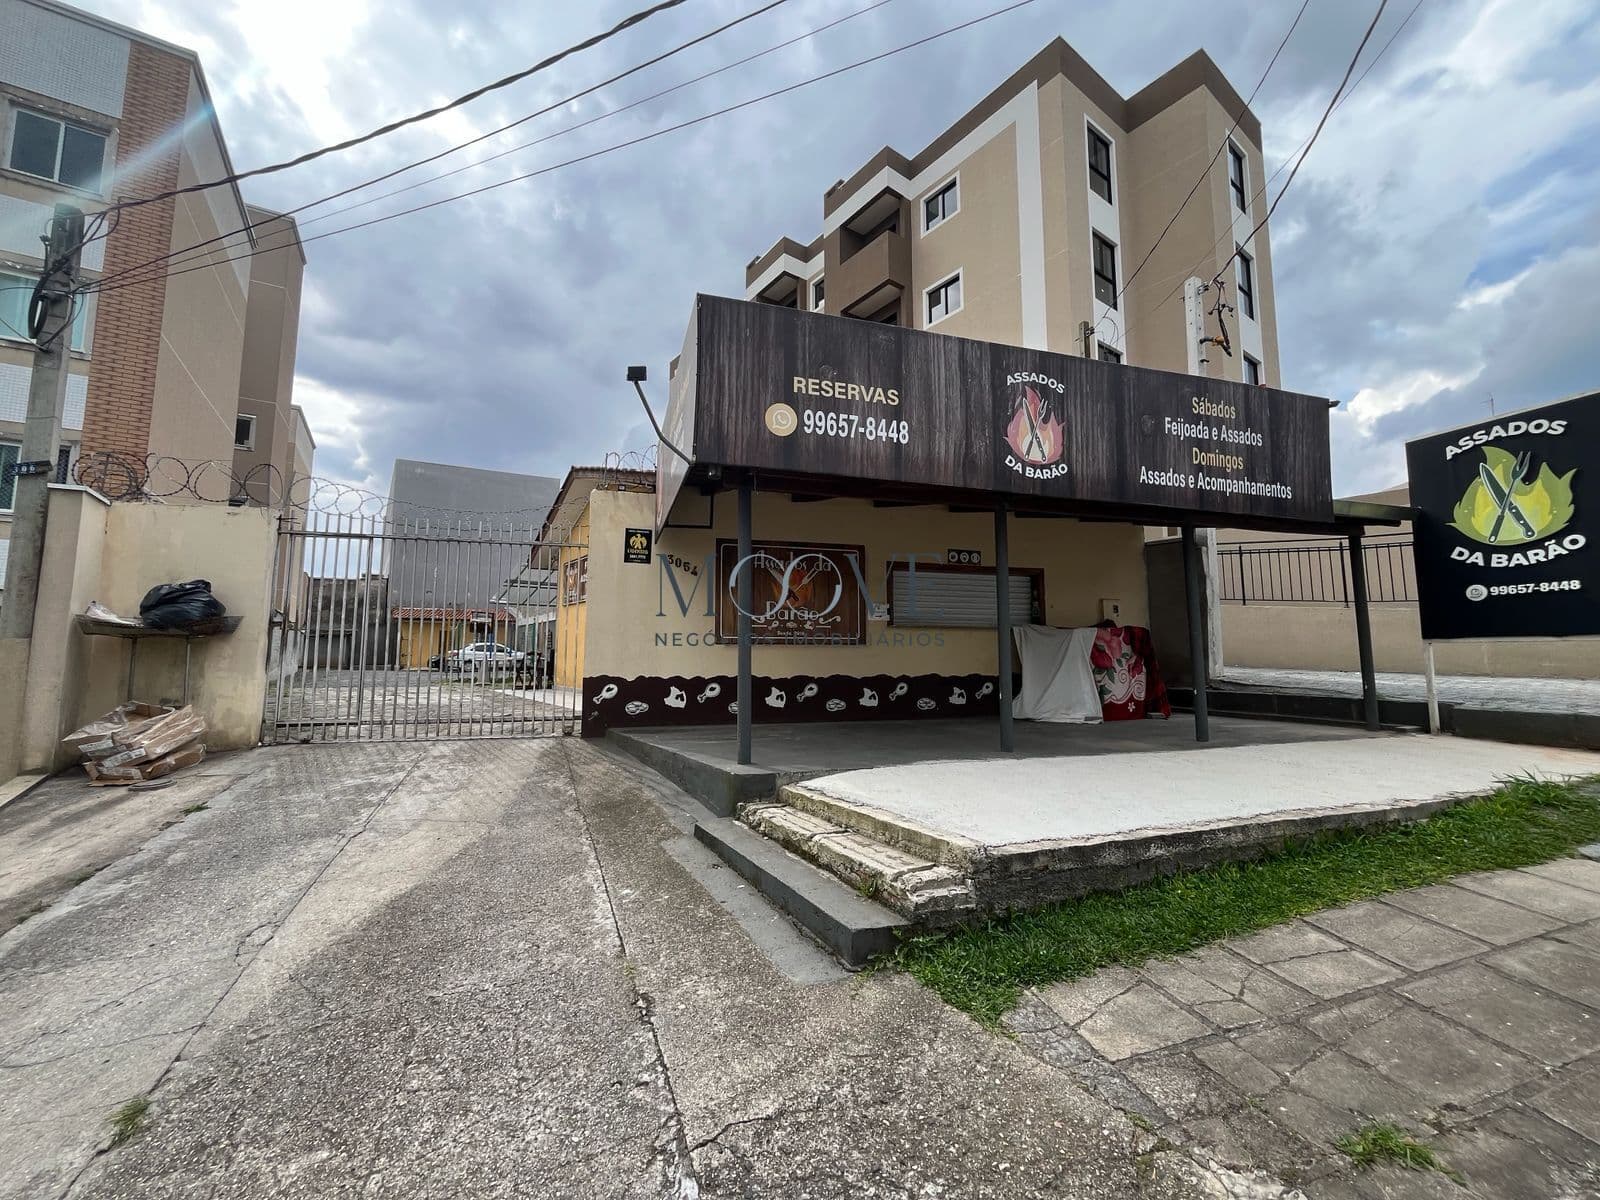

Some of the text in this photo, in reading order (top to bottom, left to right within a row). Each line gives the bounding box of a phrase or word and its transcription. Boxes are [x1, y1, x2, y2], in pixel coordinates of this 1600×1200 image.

[793, 376, 899, 406] RESERVAS
[1006, 371, 1065, 394] ASSADOS
[1192, 396, 1236, 419] Sábados
[803, 409, 909, 444] 99657-8448
[1164, 416, 1263, 447] Feijoada e Assados
[1445, 418, 1568, 461] ASSADOS
[1004, 454, 1068, 479] DA BARÃO
[1192, 447, 1244, 473] Domingos
[1139, 465, 1292, 499] Assados e Acompanhamentos
[813, 553, 832, 572] da
[1450, 534, 1586, 568] DA BARÃO
[1489, 579, 1582, 596] 99657-8448
[765, 600, 819, 621] Barão
